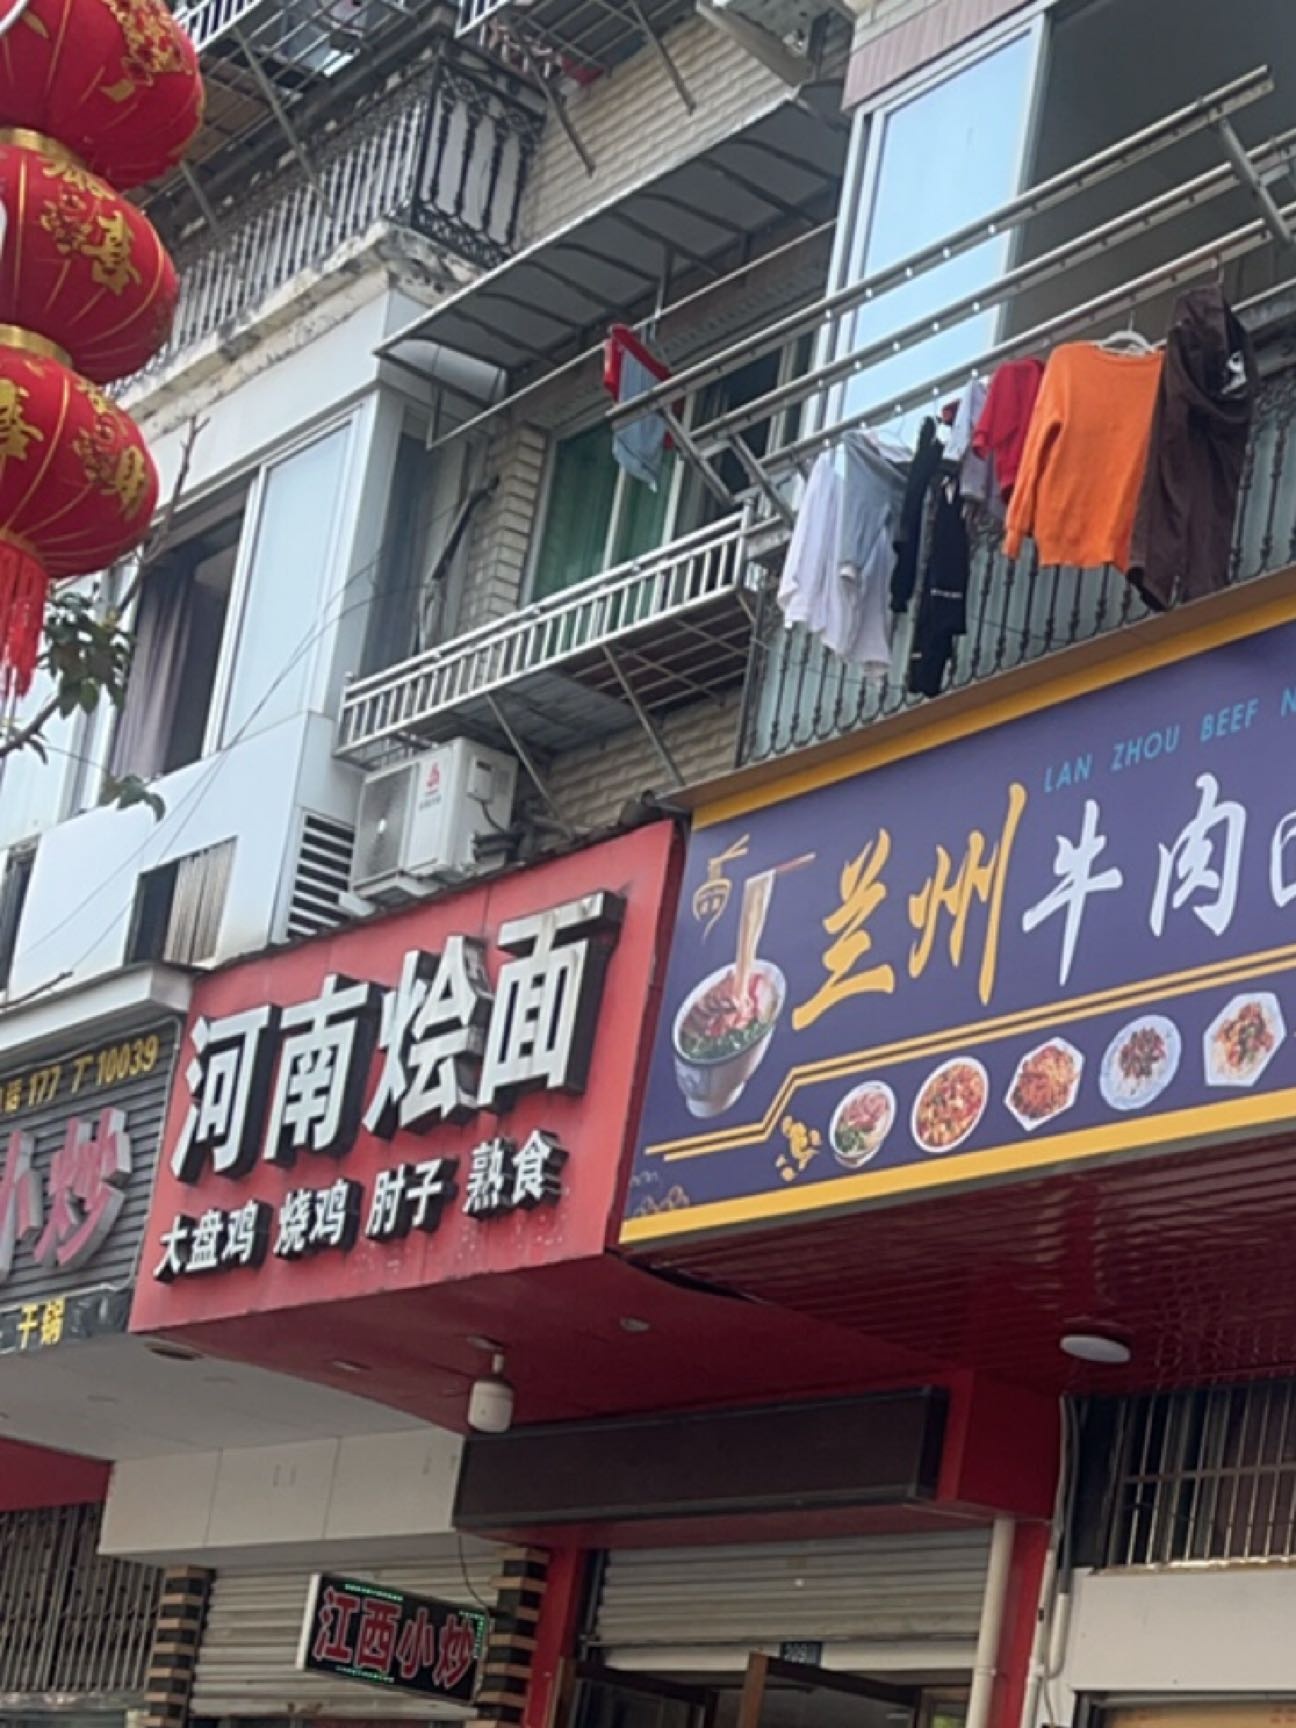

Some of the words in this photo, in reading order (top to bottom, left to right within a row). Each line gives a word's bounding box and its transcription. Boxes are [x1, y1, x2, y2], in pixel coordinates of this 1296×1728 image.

[1044, 754, 1092, 793] LAN
[1111, 724, 1180, 773] ZHOU
[1201, 698, 1259, 743] BEEF
[169, 891, 614, 1180] 河南烩面
[153, 1201, 260, 1279] 大盘鸡
[273, 1179, 352, 1257] 烧鸡
[366, 1158, 446, 1238] 肘子
[463, 1129, 556, 1214] 熟食
[312, 1585, 476, 1689] 江西小炒
